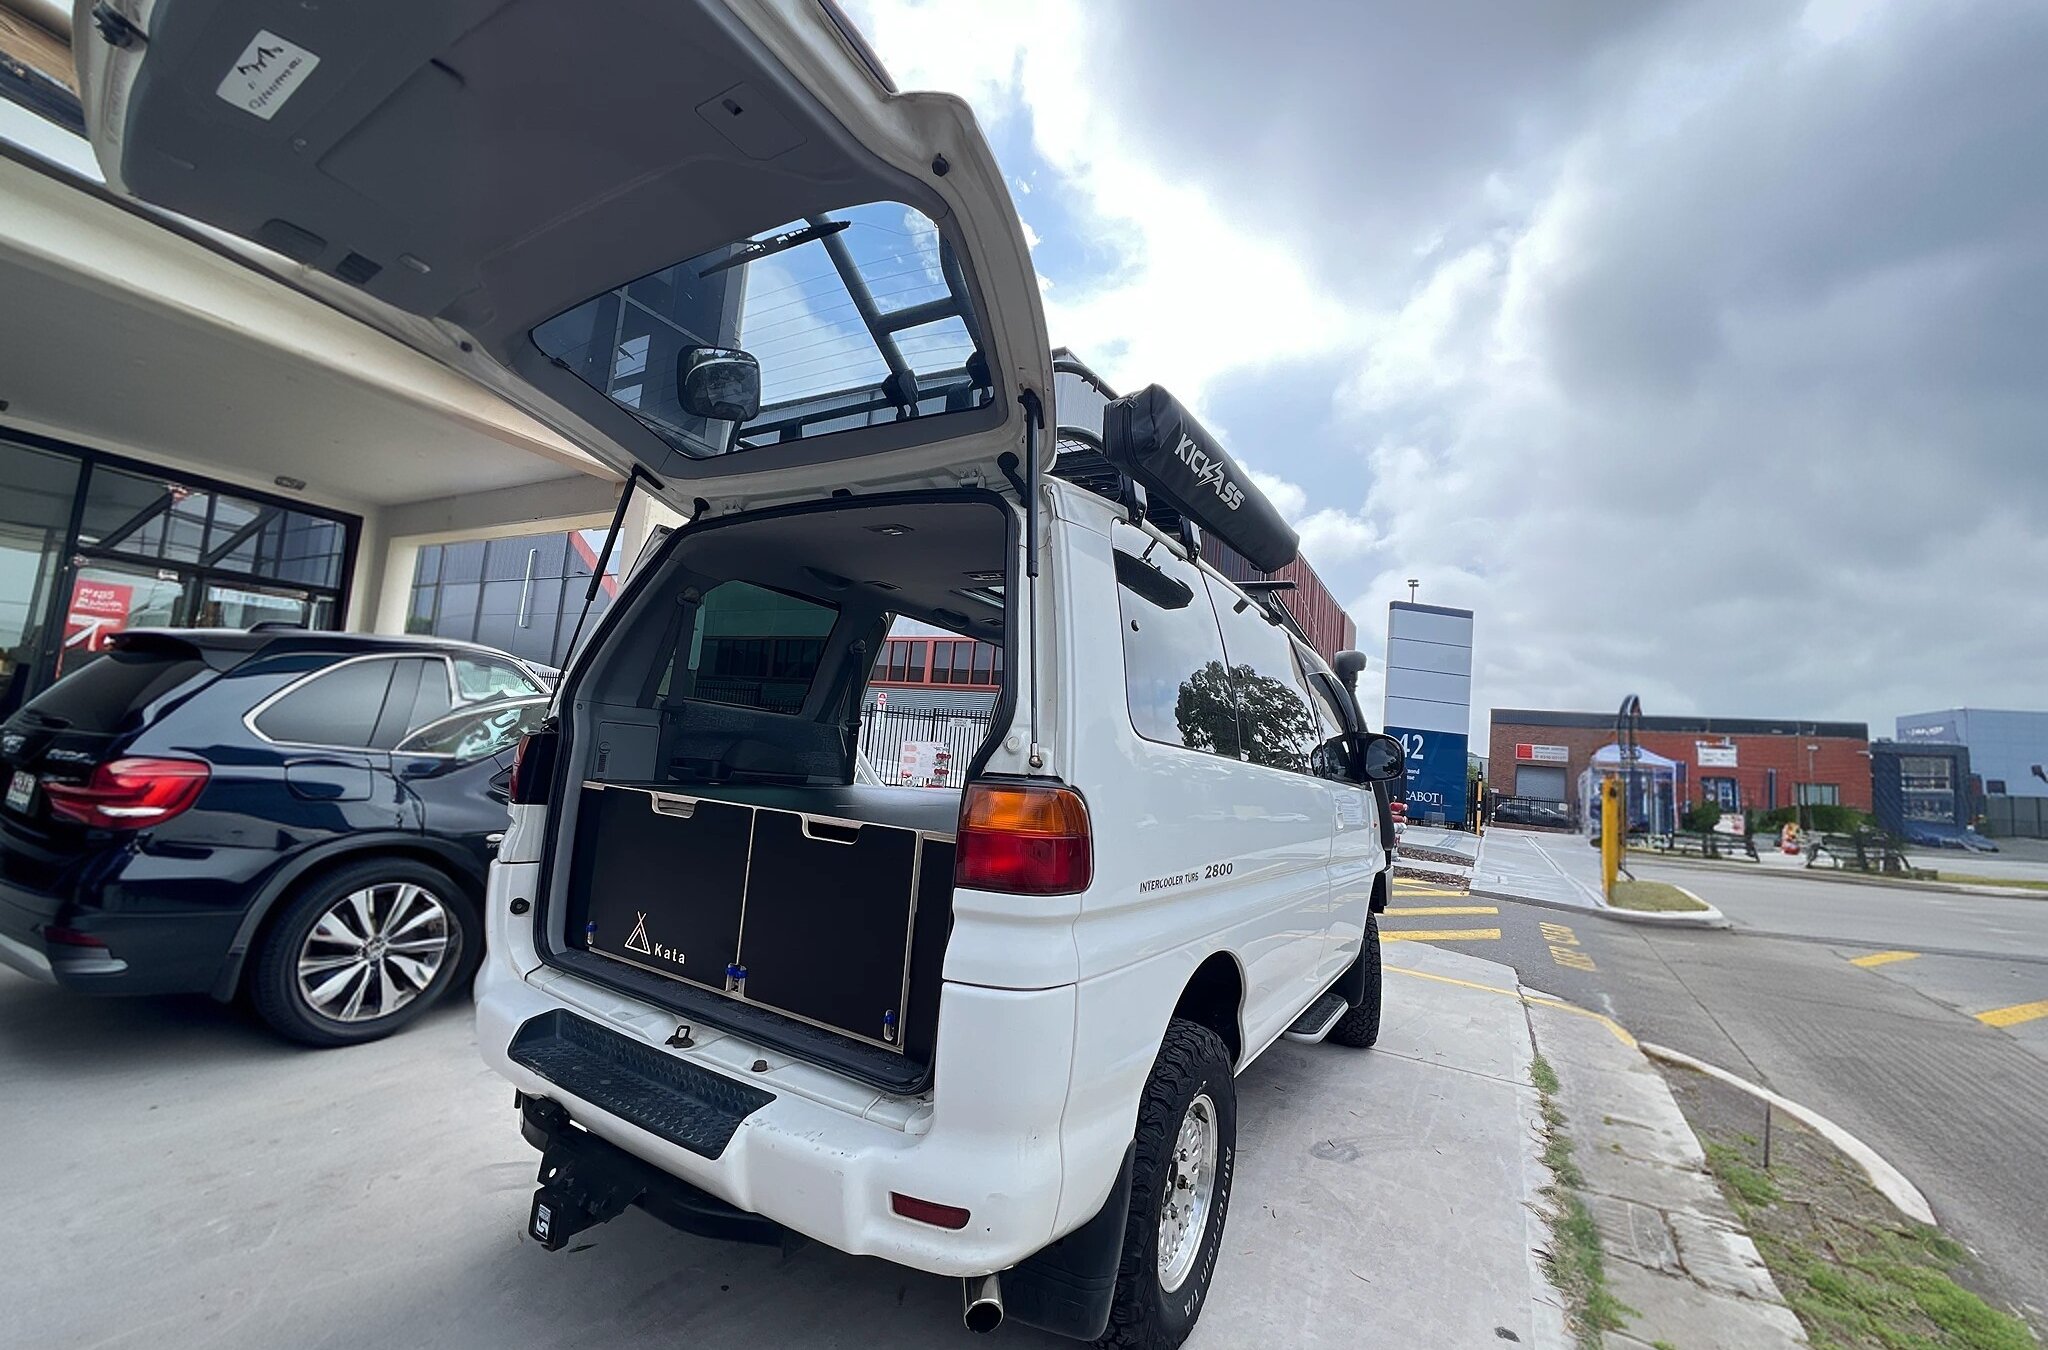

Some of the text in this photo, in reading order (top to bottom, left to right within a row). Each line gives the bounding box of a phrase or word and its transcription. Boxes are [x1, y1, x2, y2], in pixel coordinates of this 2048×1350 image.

[1174, 433, 1246, 511] KICKASS
[1400, 733, 1424, 760] 42
[1139, 875, 1184, 893] INTERCOOLER
[1204, 862, 1233, 879] 2800
[654, 942, 686, 965] Kata
